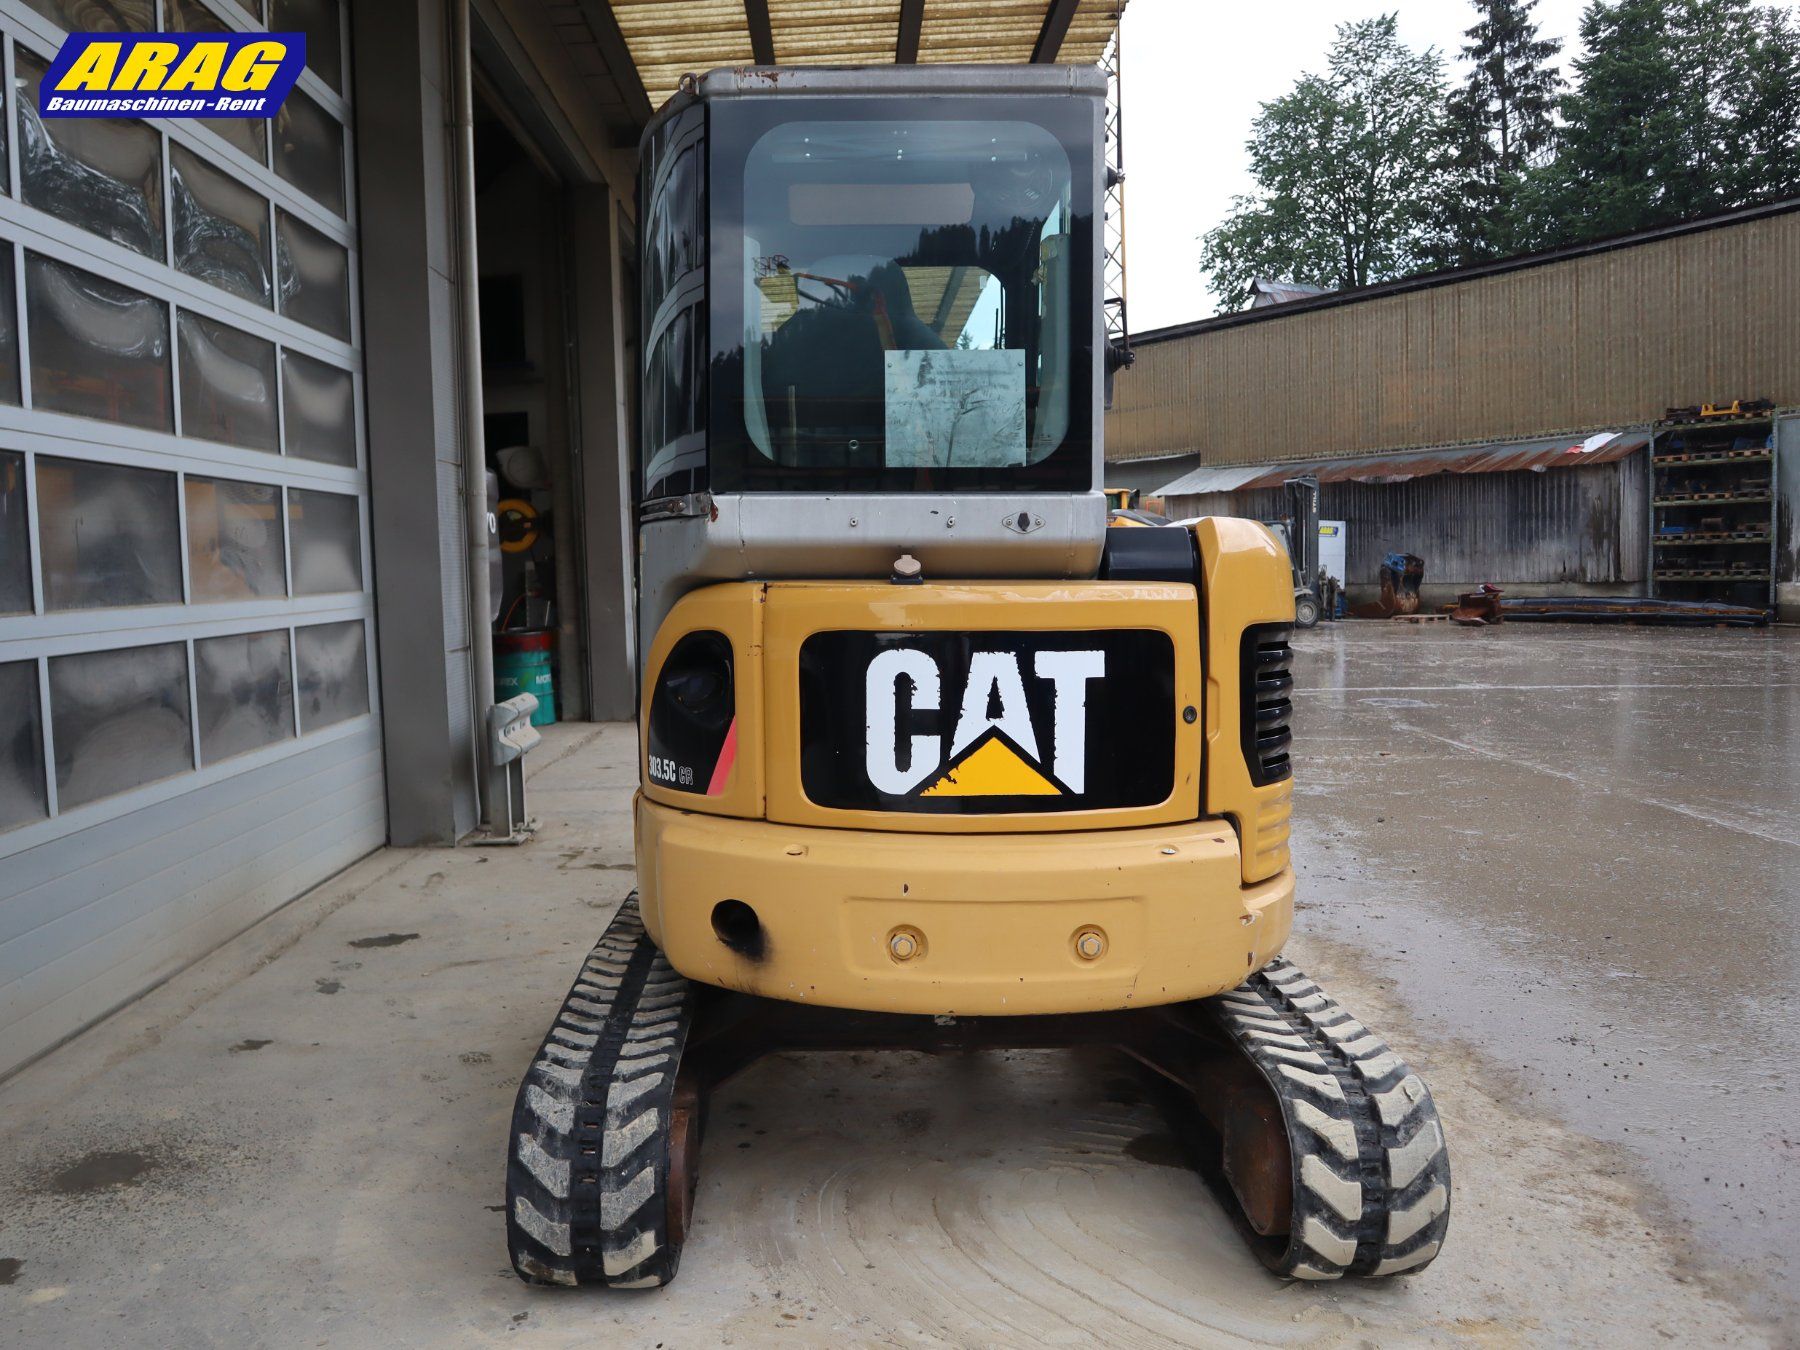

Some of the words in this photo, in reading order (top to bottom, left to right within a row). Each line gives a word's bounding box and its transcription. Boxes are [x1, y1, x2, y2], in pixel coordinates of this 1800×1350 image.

[866, 648, 1105, 795] CAT
[648, 754, 676, 782] 303.5C
[678, 765, 694, 785] CR
